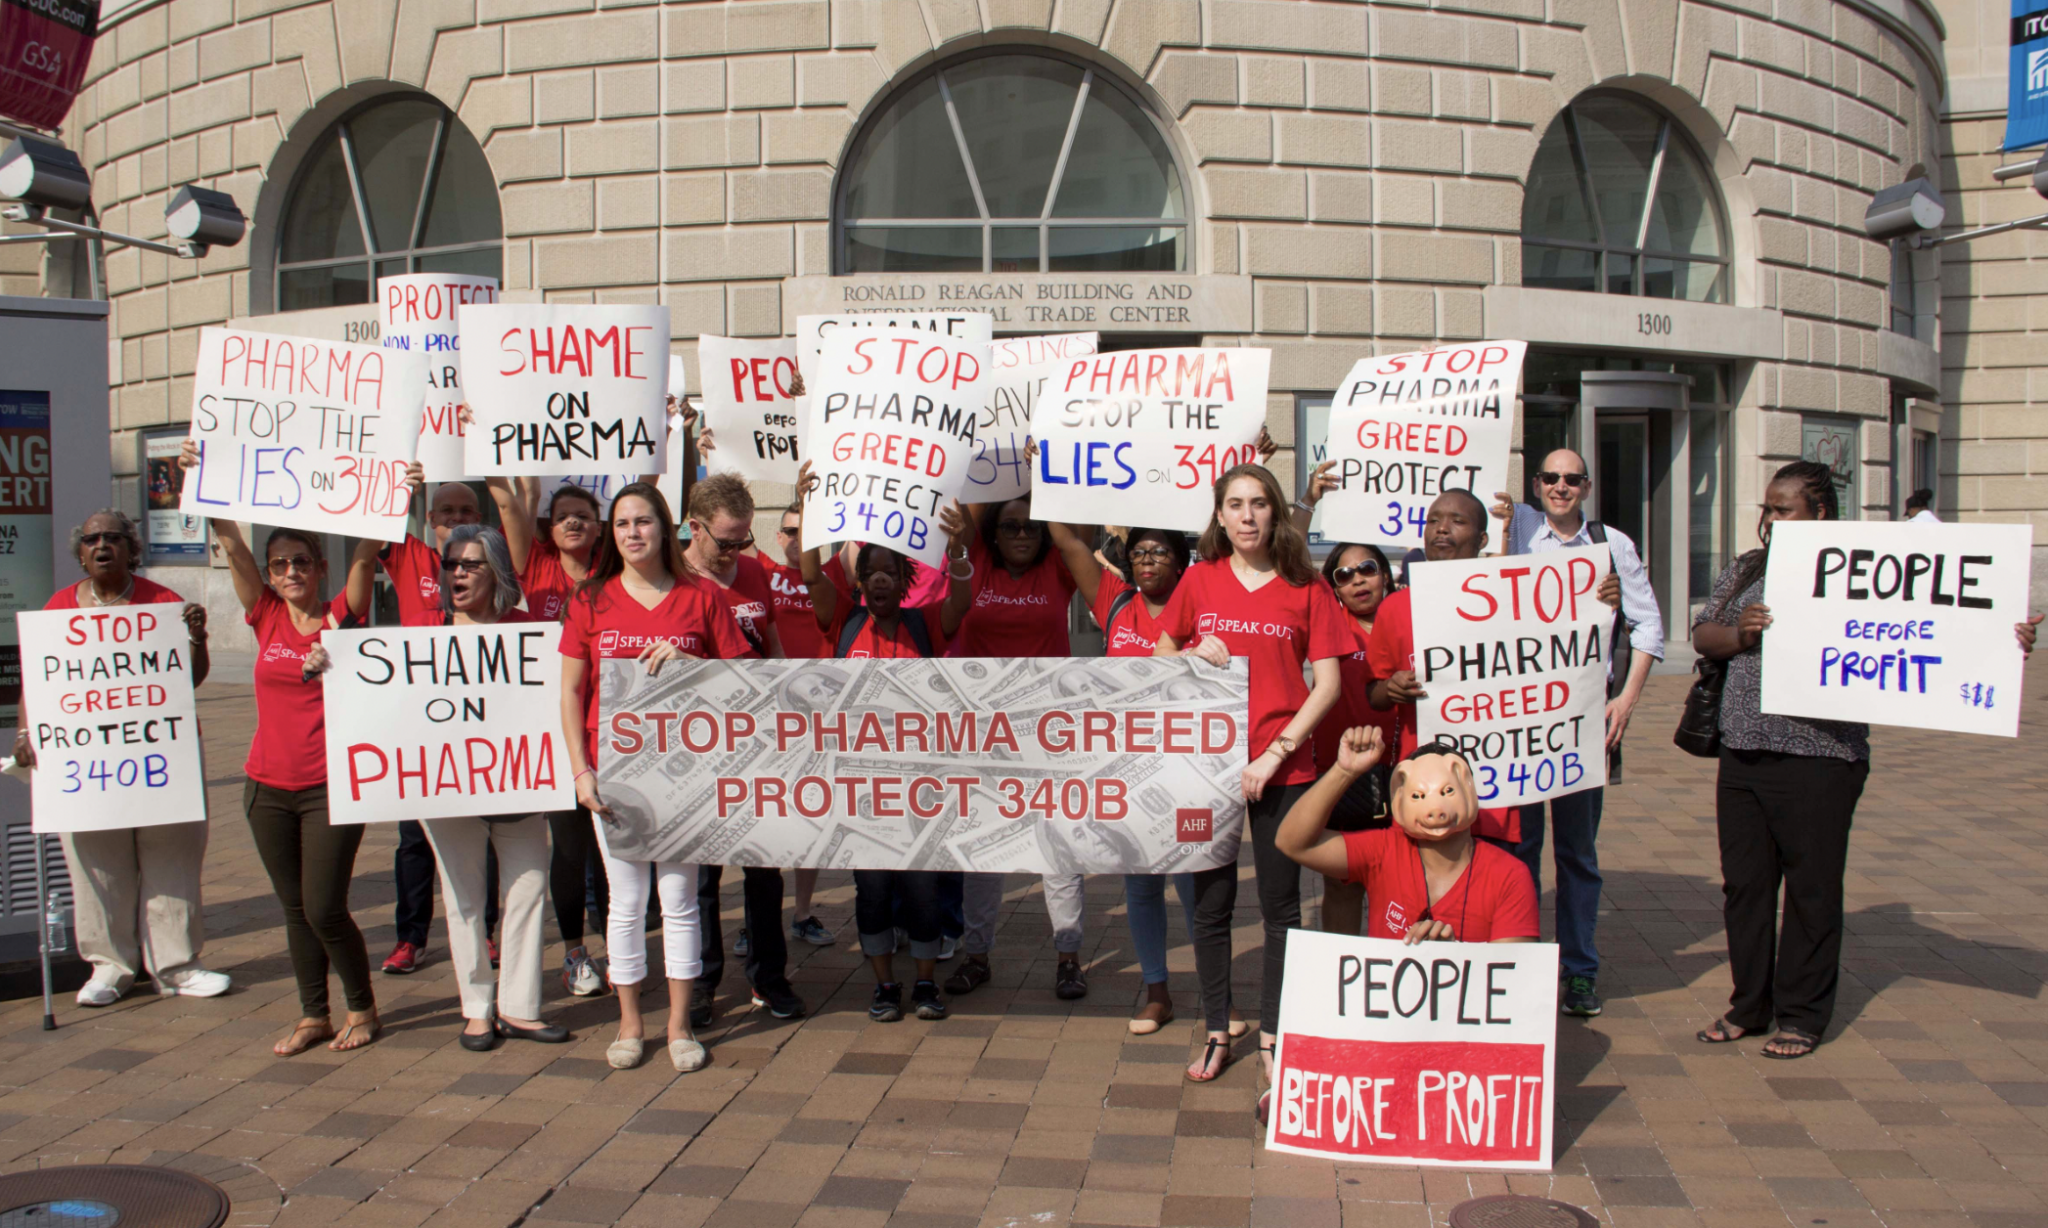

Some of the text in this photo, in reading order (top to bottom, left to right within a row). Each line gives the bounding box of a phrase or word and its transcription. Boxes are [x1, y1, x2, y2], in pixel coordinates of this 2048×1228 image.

[843, 283, 1192, 301] RONALD REAGAN BUILDING AND
[1026, 307, 1096, 322] TRADE
[1110, 306, 1191, 322] CENTER
[344, 321, 380, 342] 1300
[1638, 313, 1671, 335] 1300
[221, 336, 383, 410] PHARMA
[500, 325, 653, 379] SHAME
[847, 338, 979, 390] STOP
[1376, 347, 1508, 374] STOP
[1064, 352, 1234, 401] PHARMA
[1348, 378, 1500, 419] PHARMA
[198, 395, 381, 454] STOP THE
[547, 391, 590, 419] ON
[824, 393, 977, 447] PHARMA
[1061, 400, 1223, 429] STOP THE
[492, 417, 655, 466] PHARMA
[832, 432, 947, 478] GREED
[1357, 419, 1468, 456] GREED
[196, 440, 411, 518] LIES ON 340B
[1039, 439, 1137, 490] LIES
[1146, 469, 1171, 483] ON
[1341, 458, 1482, 496] PROTECT
[807, 473, 943, 517] PROTECT
[828, 502, 928, 550] 340B
[1456, 557, 1597, 623] STOP
[1812, 547, 1993, 610] PEOPLE
[66, 612, 157, 646] STOP
[669, 636, 697, 649] OUT
[1217, 619, 1260, 634] SPEAK
[1263, 624, 1293, 640] OUT
[1844, 619, 1934, 642] BEFORE
[44, 648, 182, 682] PHARMA
[356, 632, 544, 686] SHAME
[1424, 624, 1601, 683] PHARMA
[60, 684, 167, 714] GREED
[425, 697, 485, 723] ON
[1440, 680, 1569, 724] GREED
[37, 717, 182, 750] PROTECT
[611, 710, 1237, 754] STOP PHARMA GREED
[62, 754, 169, 794] 340B
[347, 732, 557, 802] PHARMA
[1477, 753, 1584, 800] 340B
[717, 776, 980, 818] PROTECT
[998, 778, 1129, 821] 340B
[1182, 819, 1207, 831] AHF
[1181, 844, 1212, 855] ORG
[1339, 955, 1515, 1025] PEOPLE
[1280, 1067, 1541, 1147] BEFORE PROFIT
